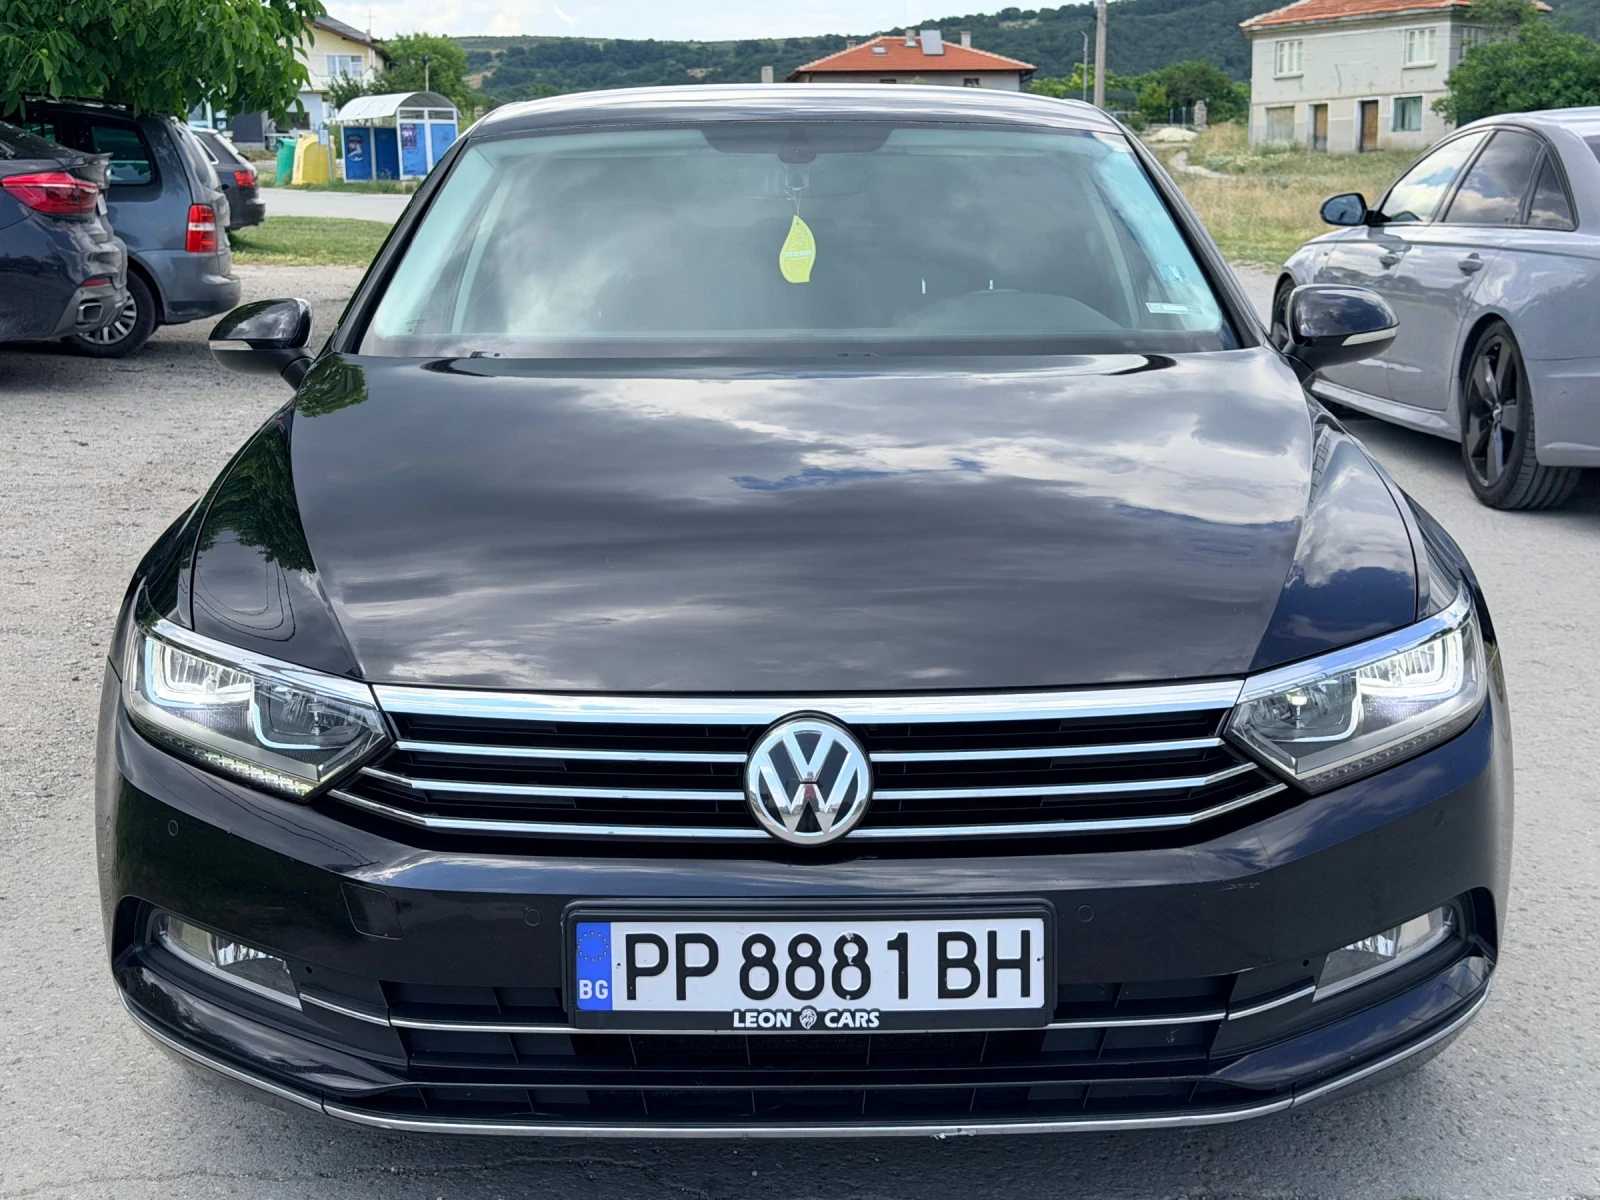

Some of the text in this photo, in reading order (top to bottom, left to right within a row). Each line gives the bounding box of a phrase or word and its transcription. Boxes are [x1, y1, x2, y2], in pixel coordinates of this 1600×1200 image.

[625, 929, 1031, 1001] PP 8881 BH
[579, 979, 608, 1000] BG
[733, 1011, 880, 1028] LEON CARS
